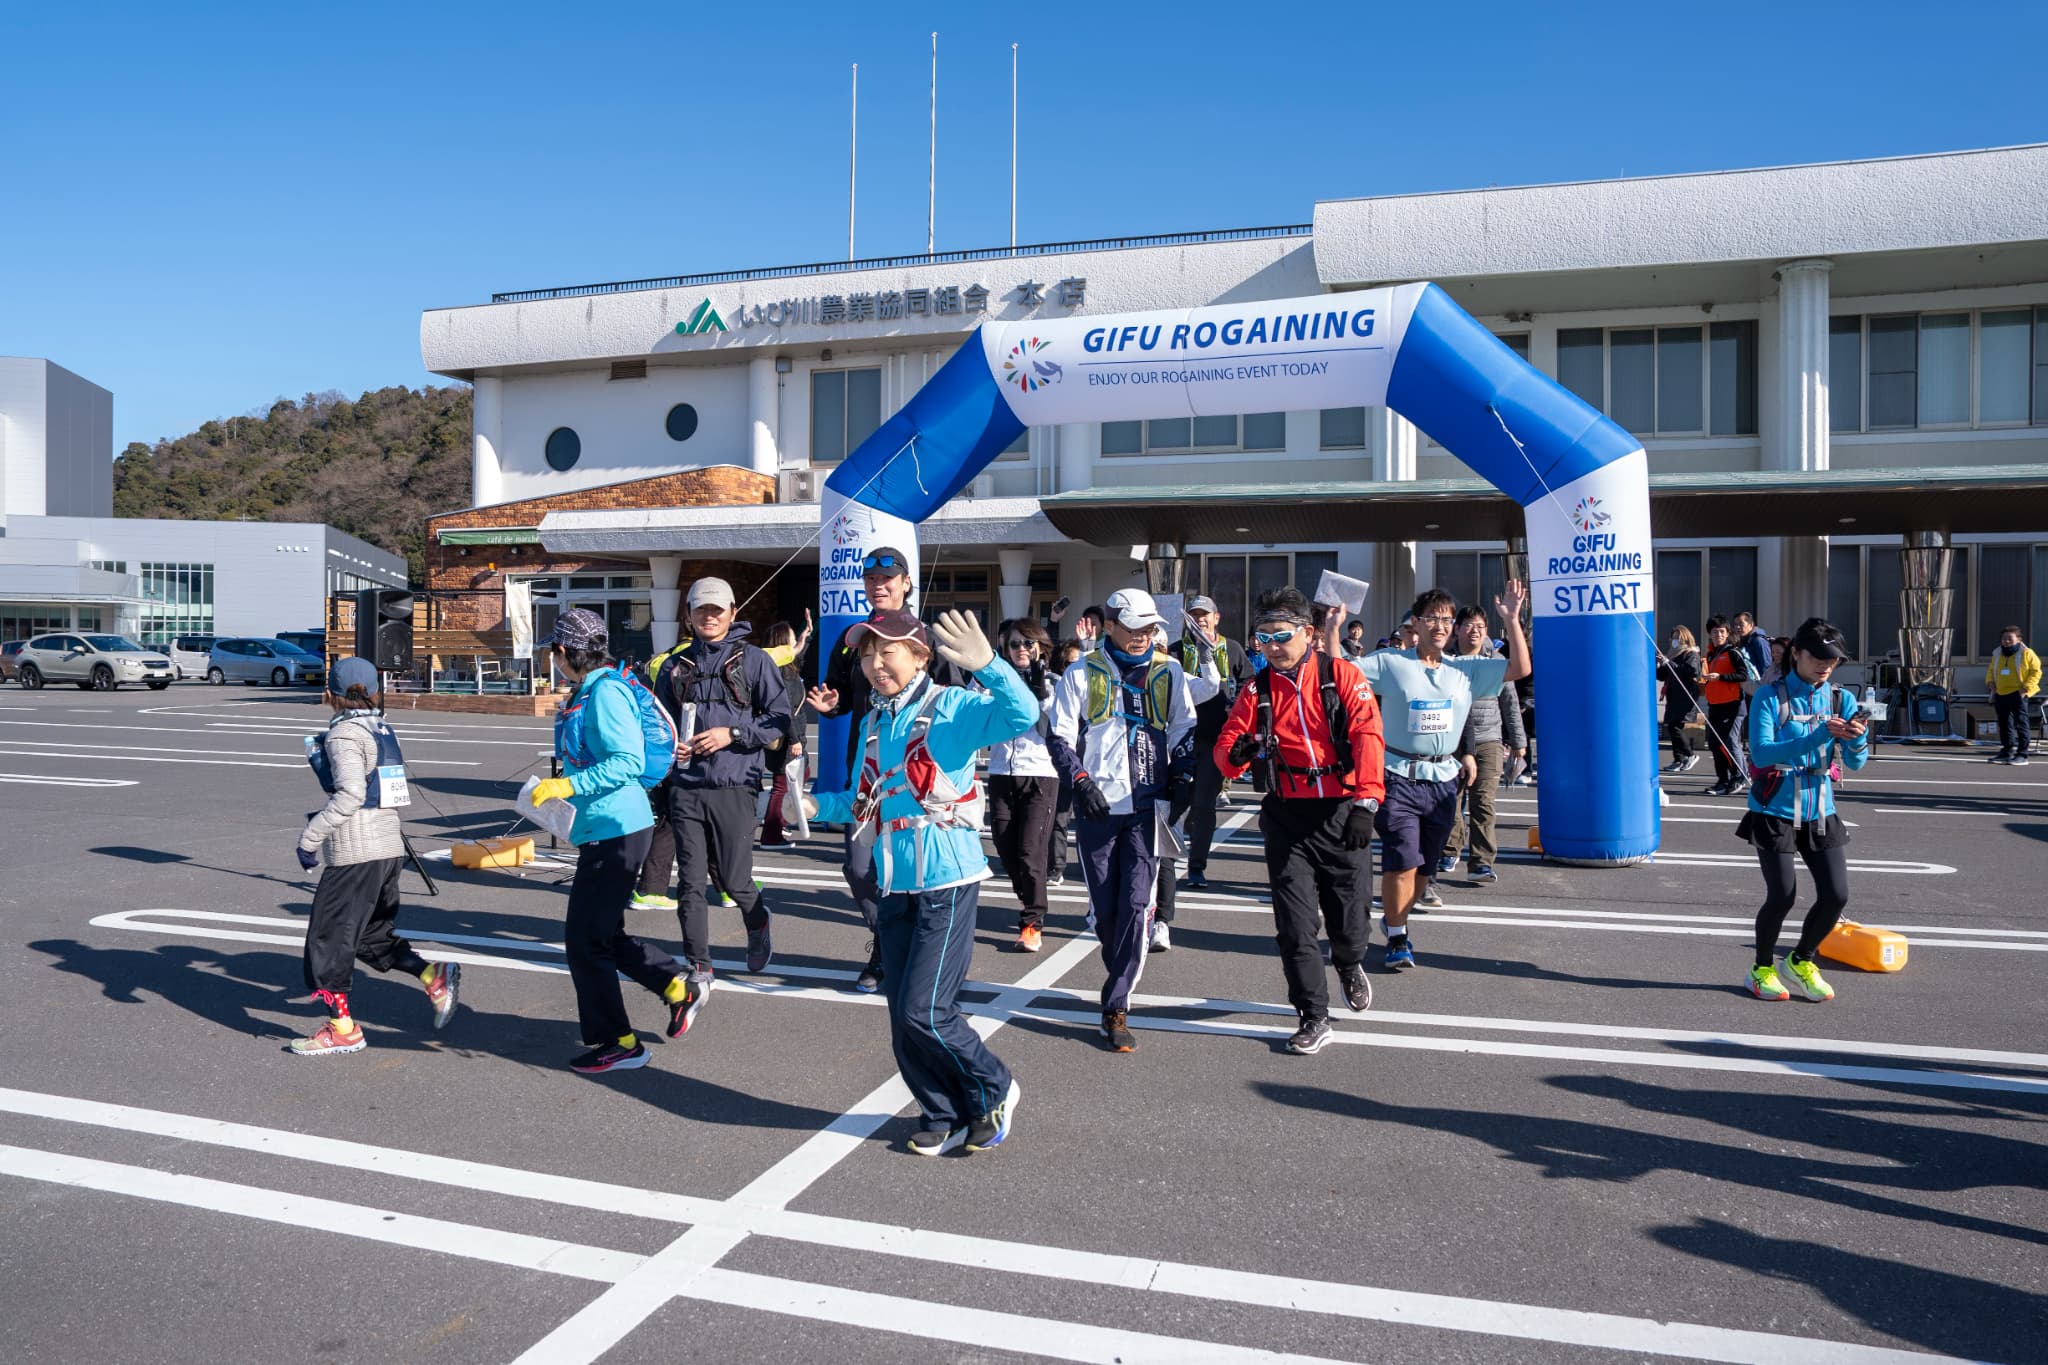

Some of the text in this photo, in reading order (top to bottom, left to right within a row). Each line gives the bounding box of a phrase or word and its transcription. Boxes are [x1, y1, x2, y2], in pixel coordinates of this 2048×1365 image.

[739, 283, 989, 328] いび川農業協同組合
[1083, 309, 1376, 353] GIFU ROGAINING
[1089, 362, 1329, 386] ENJOY OUR ROGAINING EVENT TODAY
[1572, 533, 1616, 553] GIFU
[831, 548, 862, 563] GIFU
[1548, 553, 1642, 575] ROGAINING
[821, 565, 861, 581] ROGAIN
[822, 590, 869, 613] STAR
[1554, 582, 1640, 613] START
[1421, 713, 1440, 721] 3492
[1136, 730, 1150, 786] RECORD
